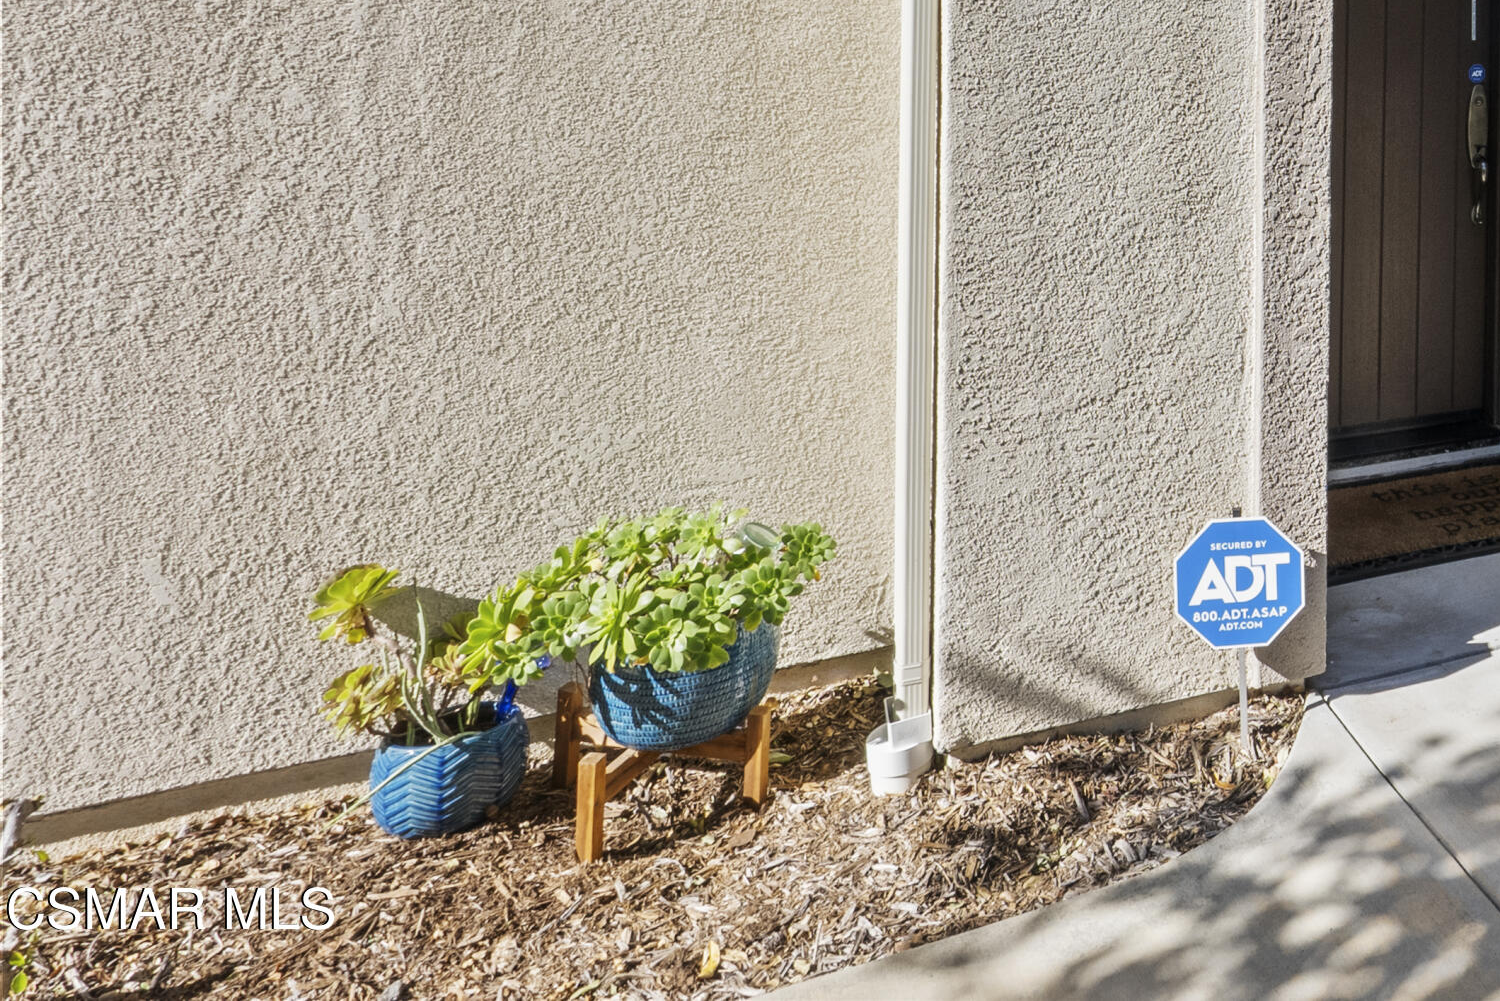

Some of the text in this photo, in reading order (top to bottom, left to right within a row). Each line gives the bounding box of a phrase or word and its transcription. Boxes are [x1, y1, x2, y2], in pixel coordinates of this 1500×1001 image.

[1210, 540, 1267, 551] SECURED BY
[1188, 552, 1290, 606] ADT
[1192, 606, 1288, 623] 800.ADT.ASAP
[1218, 621, 1263, 631] ADT.COM
